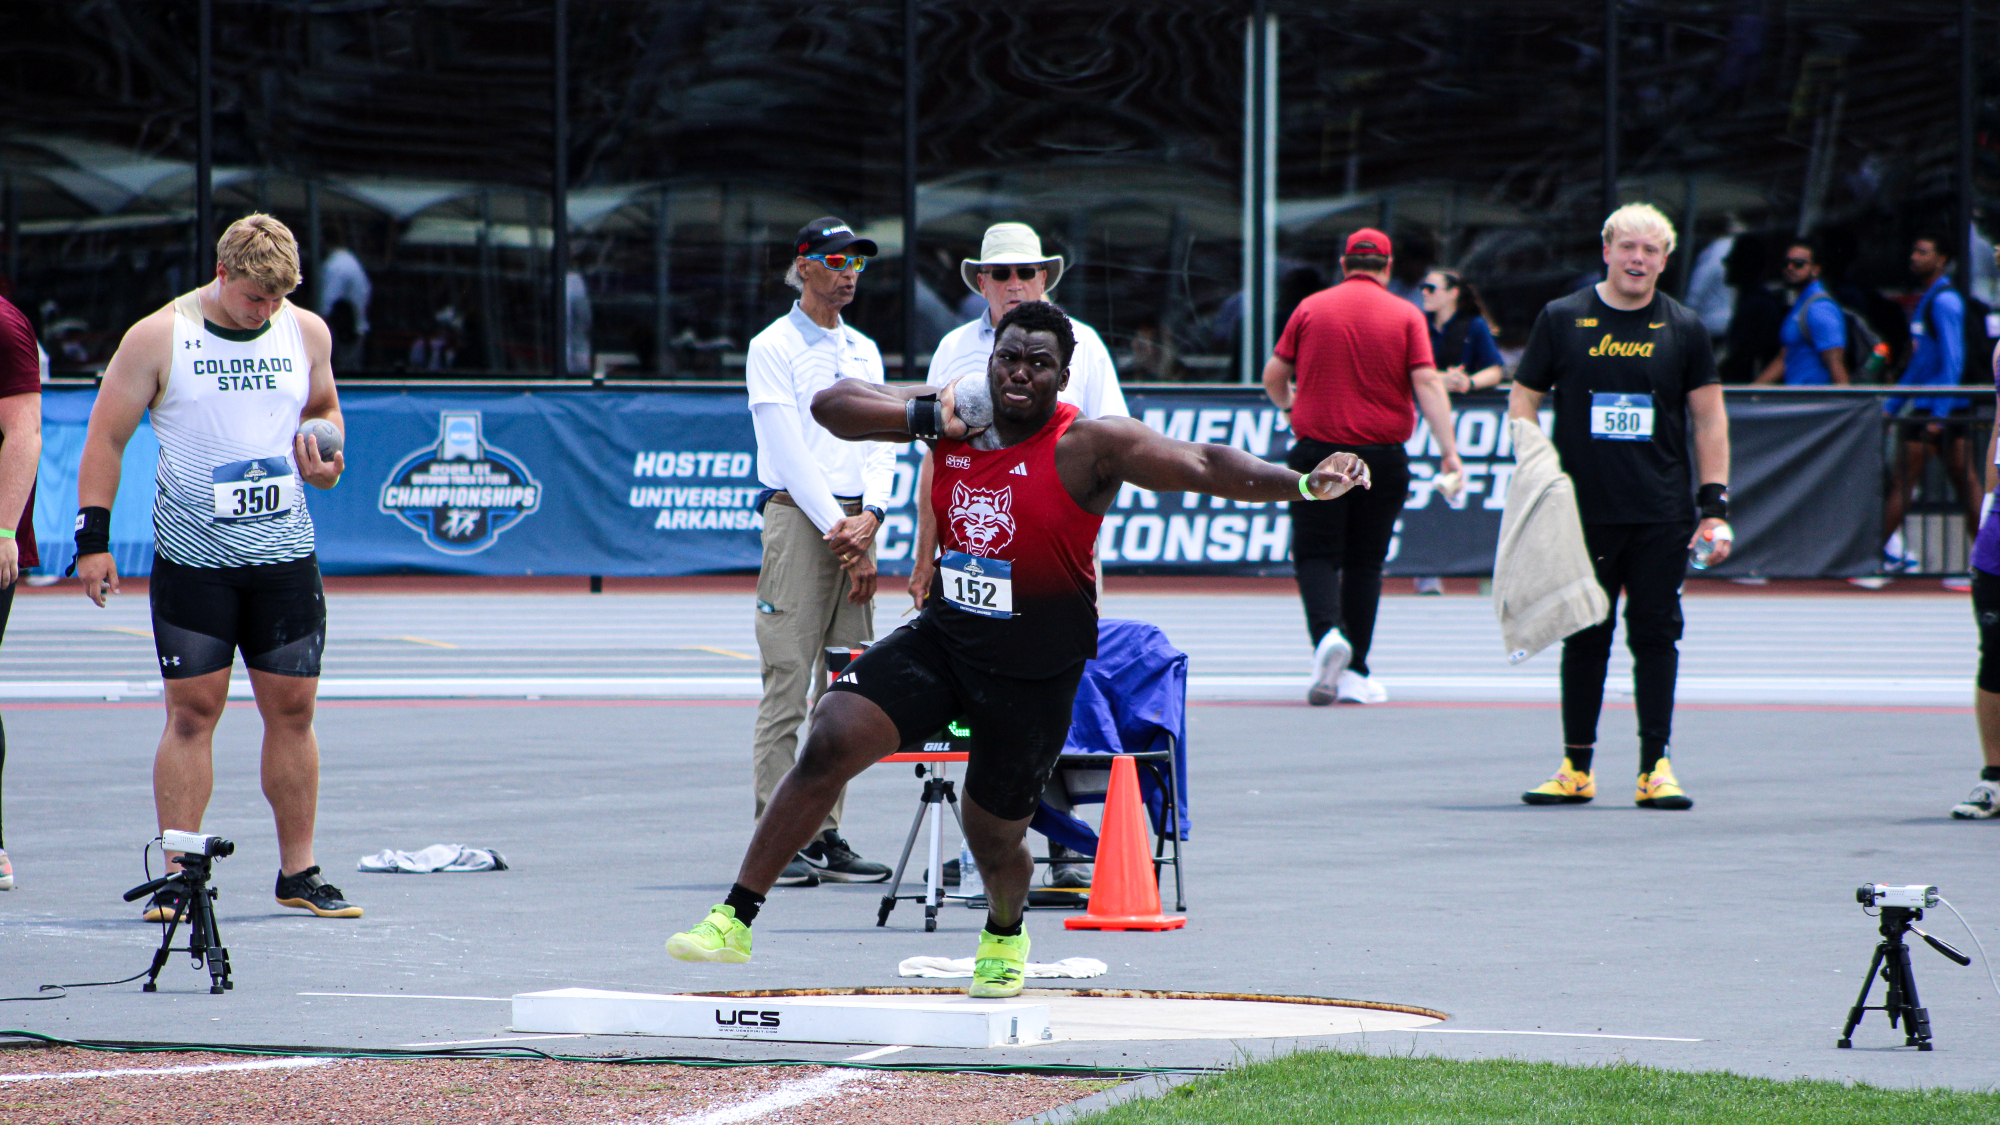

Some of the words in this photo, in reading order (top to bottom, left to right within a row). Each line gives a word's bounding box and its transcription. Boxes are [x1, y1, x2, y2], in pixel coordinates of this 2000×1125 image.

[1588, 333, 1655, 357] Iowa
[193, 358, 293, 375] COLORADO
[217, 374, 277, 391] STATE
[1604, 411, 1640, 432] 580
[1141, 409, 1297, 457] MEN'
[633, 451, 753, 477] HOSTED
[232, 484, 280, 516] 350
[384, 486, 536, 507] CHAMPIONSHIPS
[629, 487, 768, 508] UNIVERSIT
[654, 509, 764, 530] ARKANSA
[954, 576, 997, 608] 152
[923, 742, 951, 752] GILL
[715, 1009, 781, 1027] UCS
